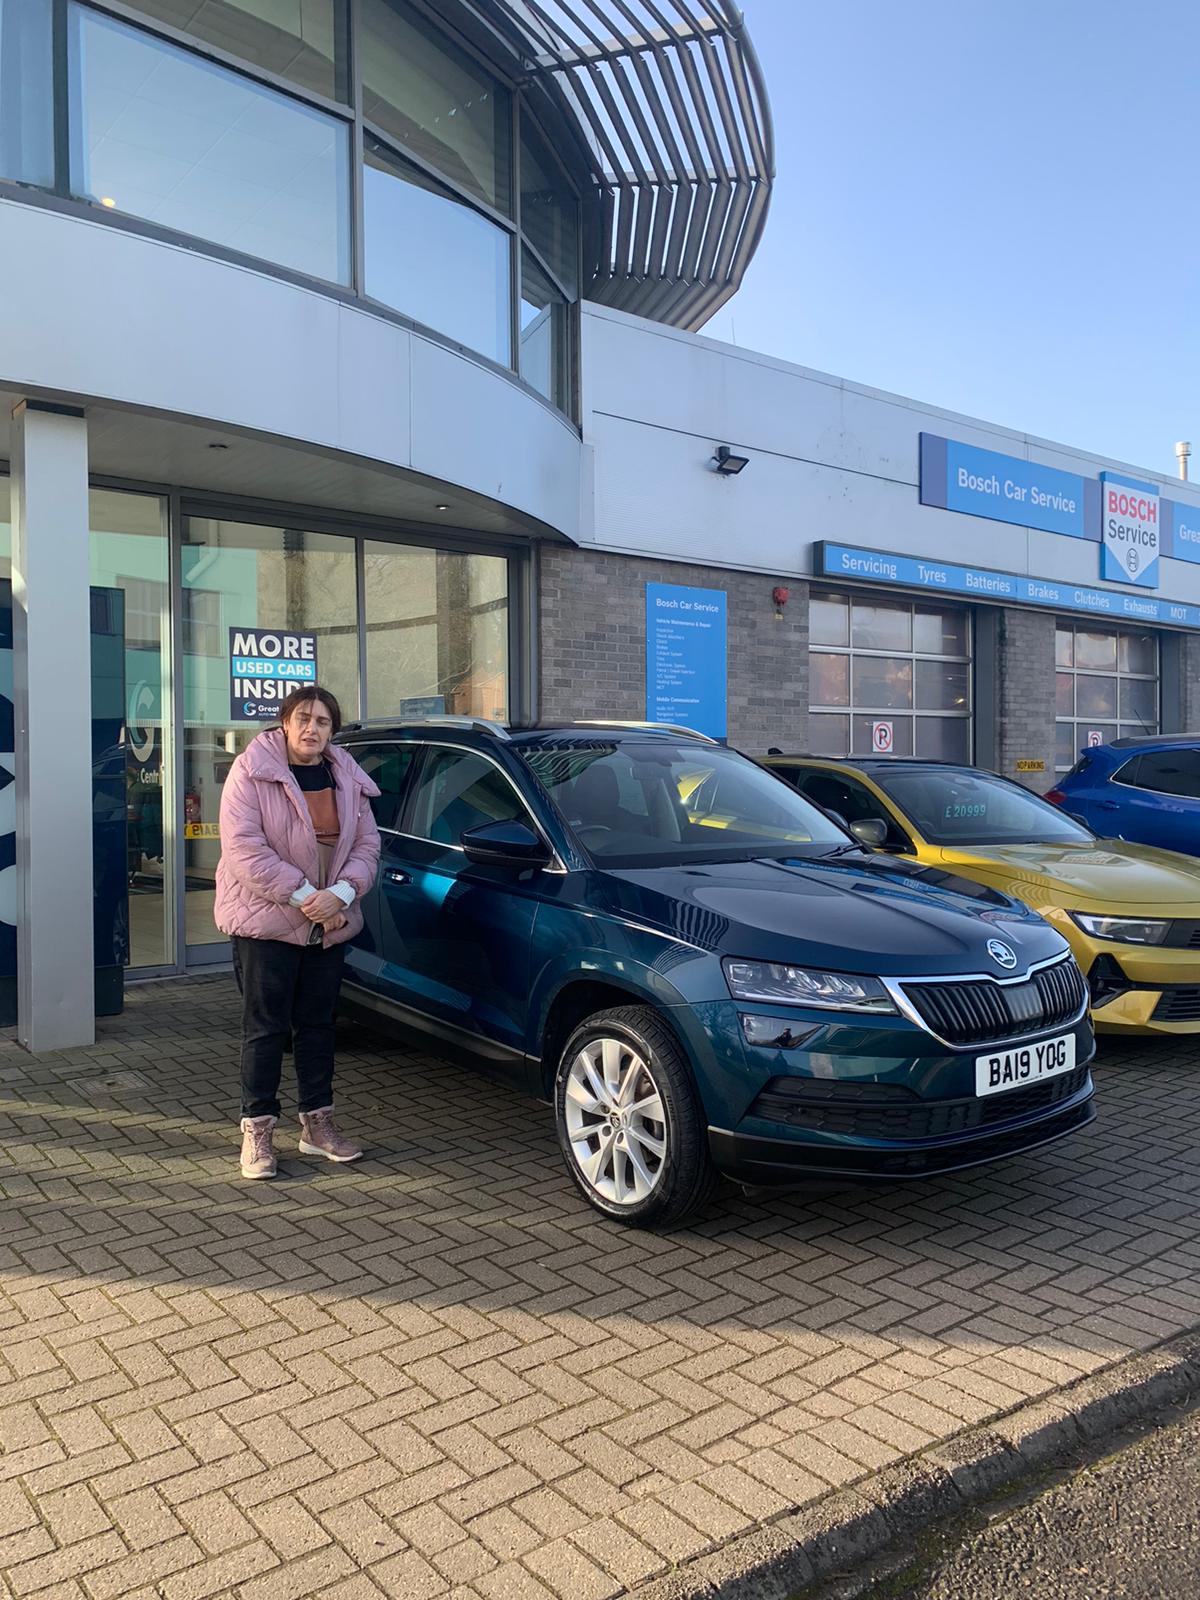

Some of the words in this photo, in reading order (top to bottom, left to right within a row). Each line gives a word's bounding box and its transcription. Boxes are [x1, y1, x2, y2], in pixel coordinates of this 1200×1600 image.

[958, 468, 1000, 495] Bosch
[1004, 480, 1027, 502] Car
[1031, 487, 1076, 514] Service
[1108, 490, 1157, 523] BOSCH
[1108, 519, 1157, 548] Service
[842, 553, 897, 580] Servicing
[918, 565, 947, 583] Tyres
[966, 573, 1011, 593] Batteries
[1028, 583, 1059, 600] Brakes
[1074, 591, 1110, 608] Clutches
[1124, 599, 1158, 616] Exhausts
[1170, 607, 1187, 620] MOT
[656, 598, 678, 609] Bosch
[680, 600, 692, 610] Car
[694, 602, 719, 613] Service
[233, 633, 314, 659] MORE
[236, 661, 273, 674] USED
[277, 663, 312, 676] CARS
[234, 678, 315, 699] INSID
[258, 705, 279, 713] Great
[953, 804, 986, 818] 20999
[989, 1050, 1030, 1087] BA19
[1036, 1040, 1066, 1074] YOG
